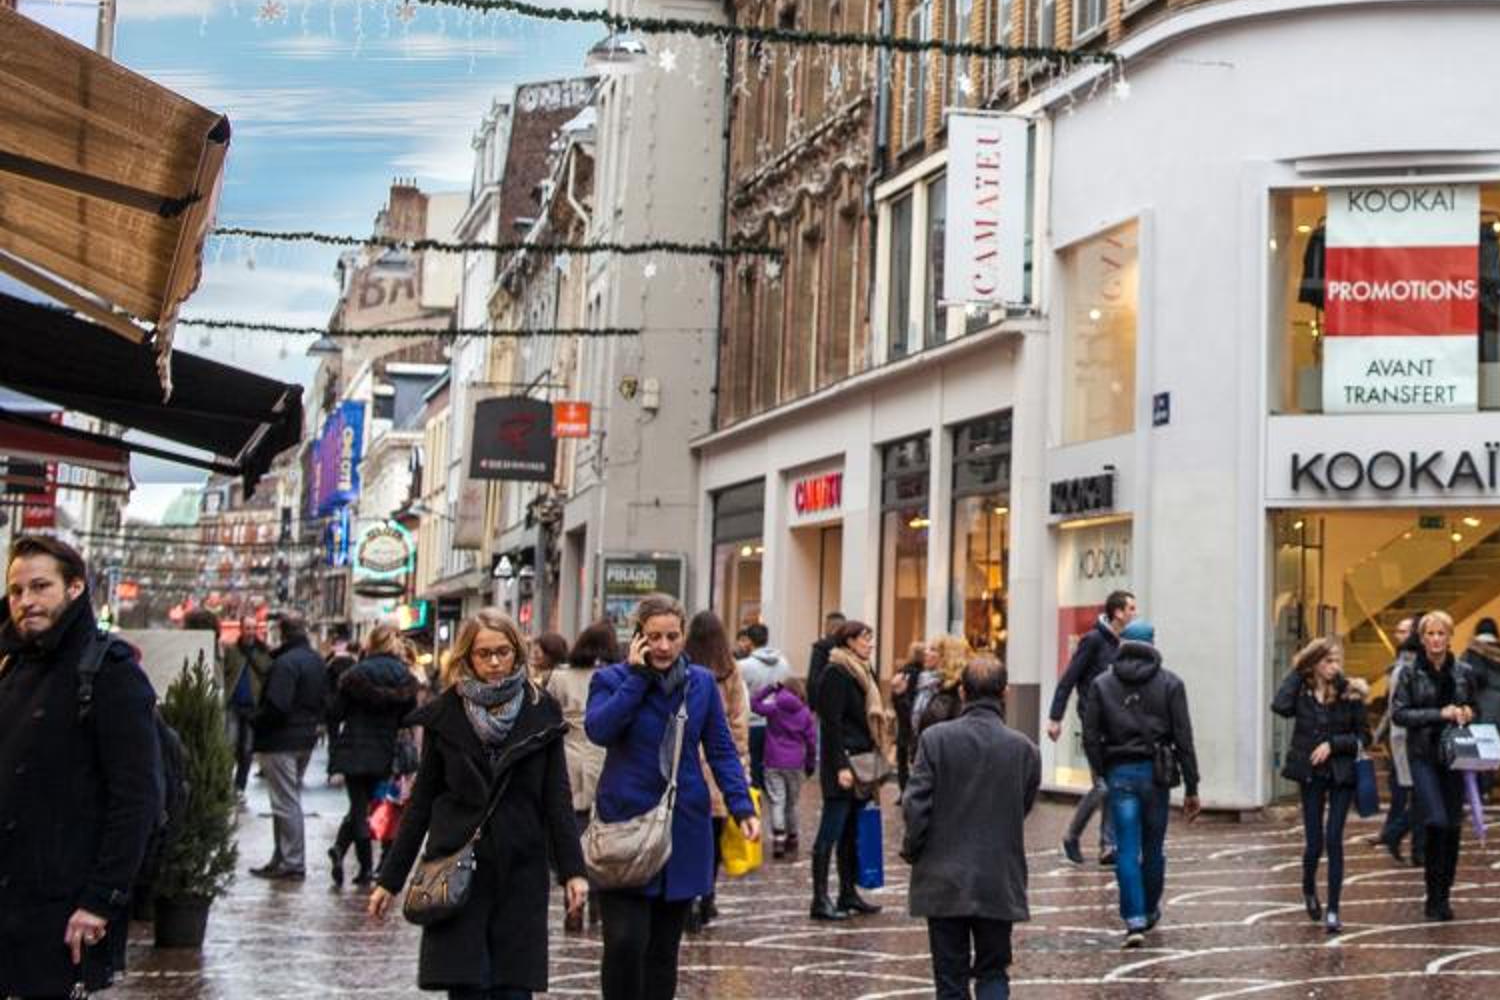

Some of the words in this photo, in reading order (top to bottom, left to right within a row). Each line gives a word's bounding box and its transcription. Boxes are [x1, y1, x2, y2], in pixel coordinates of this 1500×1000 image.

[1327, 279, 1478, 301] PROMOTIONS
[1365, 359, 1435, 377] AVANT
[1344, 386, 1457, 404] TRANSFERT
[1291, 441, 1500, 492] KOOKAÏ
